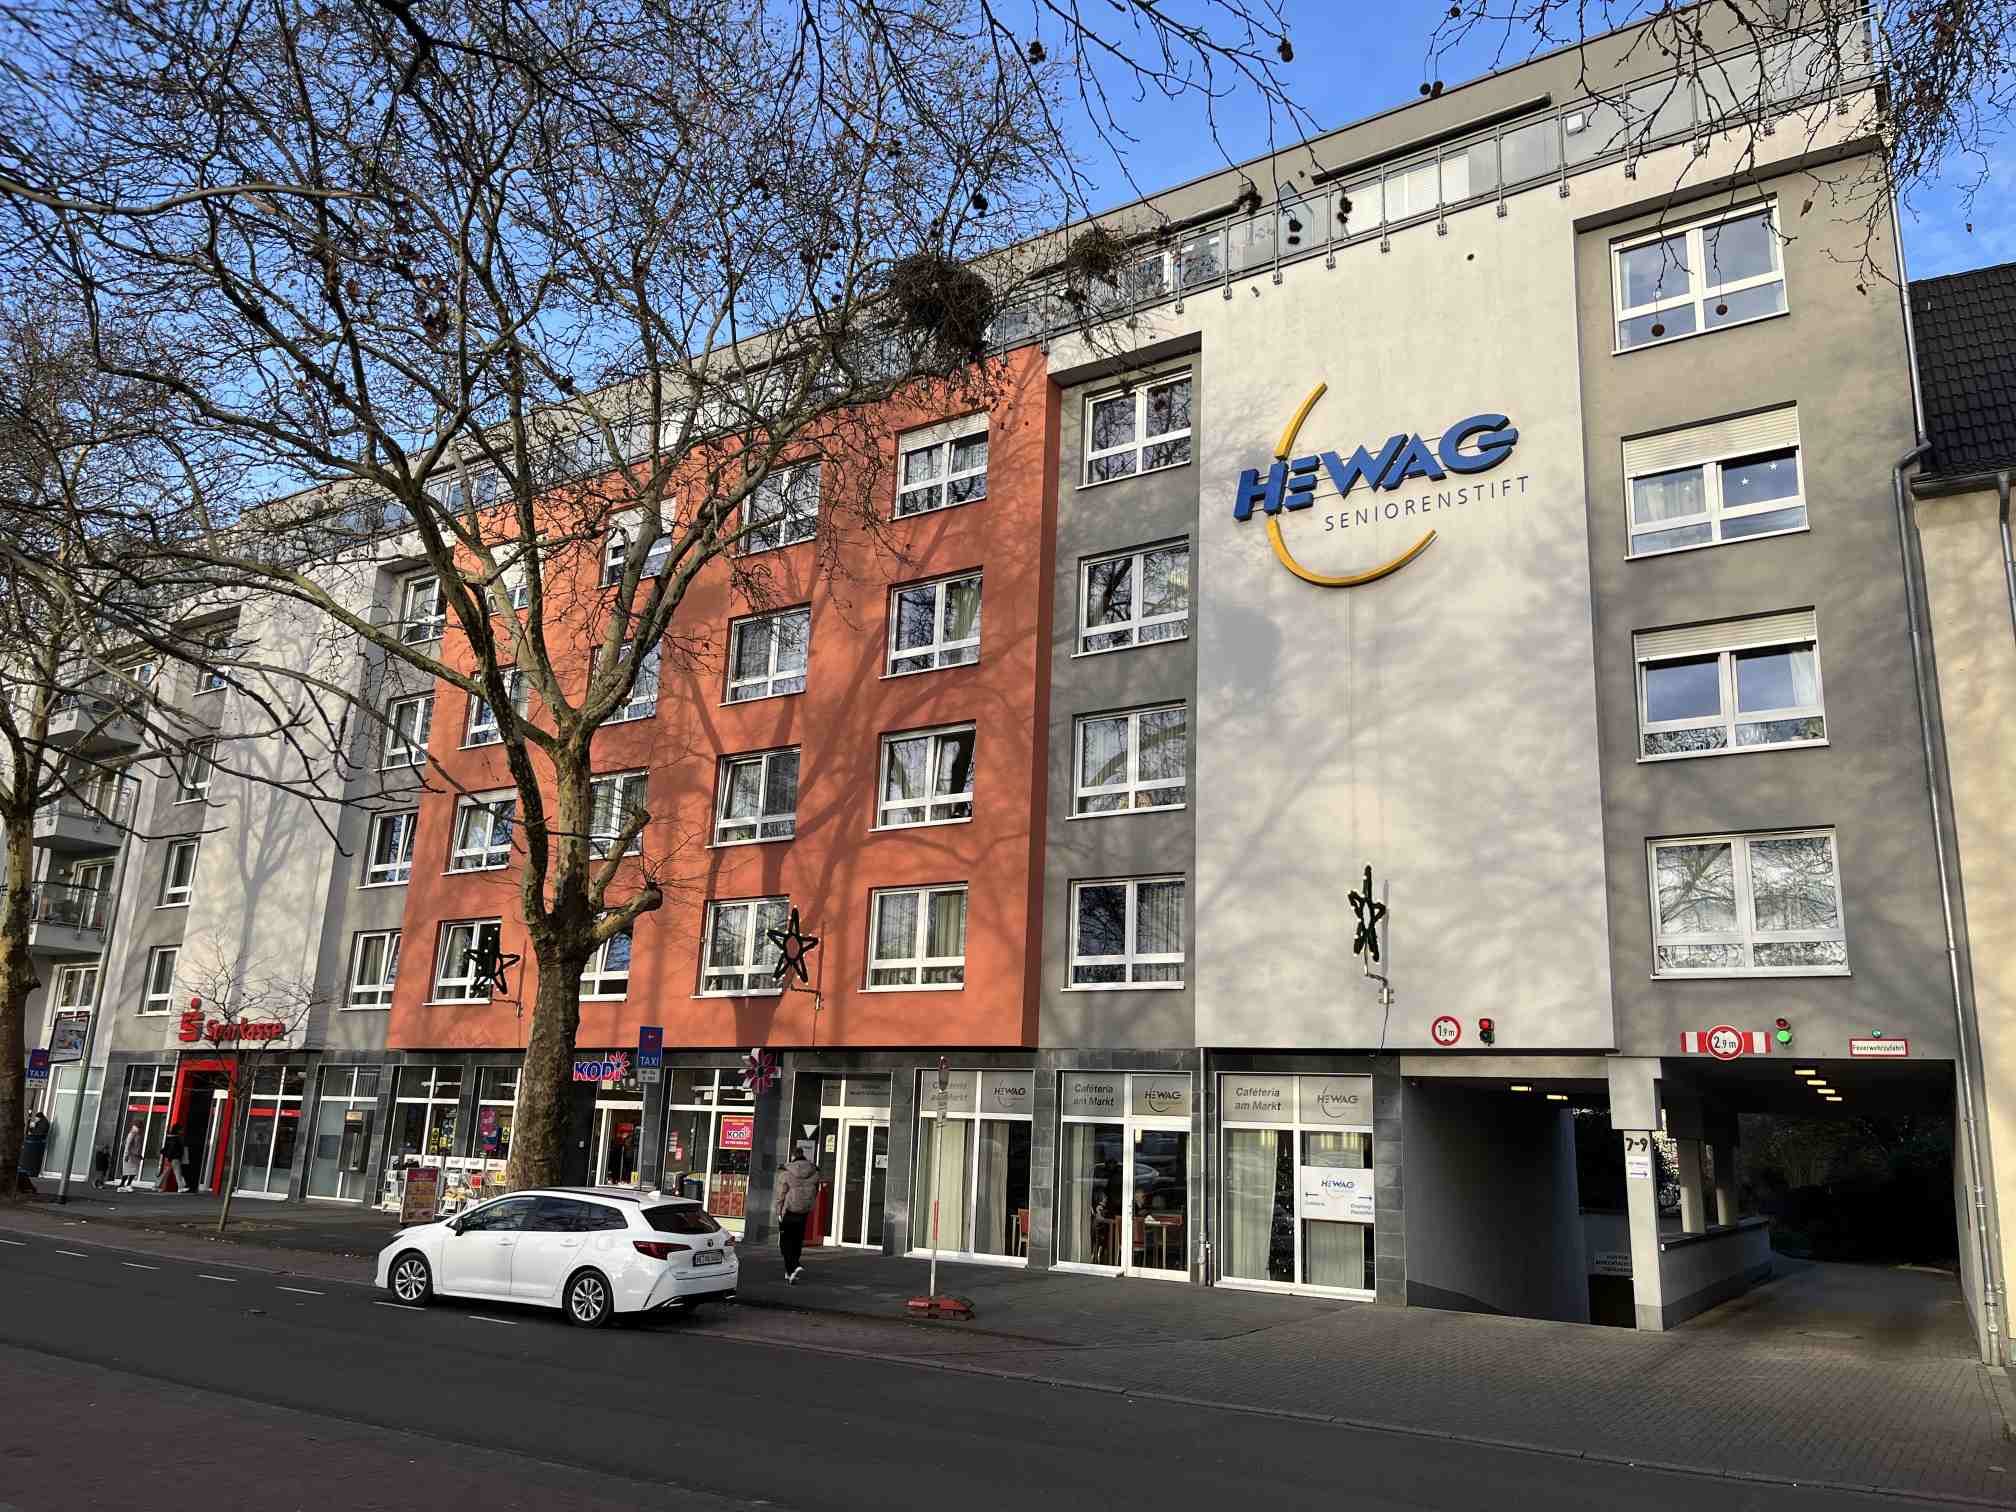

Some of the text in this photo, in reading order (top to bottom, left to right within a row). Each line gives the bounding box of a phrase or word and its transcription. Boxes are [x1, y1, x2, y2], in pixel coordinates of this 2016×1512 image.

[1233, 414, 1519, 522] HEWAG
[1324, 476, 1529, 532] SENIORENSTIFT
[639, 1056, 660, 1065] TAXI
[1144, 1090, 1182, 1100] HEWAG
[1317, 1094, 1359, 1105] HEWAG
[1088, 1096, 1115, 1106] Markt
[1234, 1100, 1282, 1112] am Markt
[1625, 1137, 1649, 1152] 7-9
[1320, 1179, 1354, 1189] HEWAG
